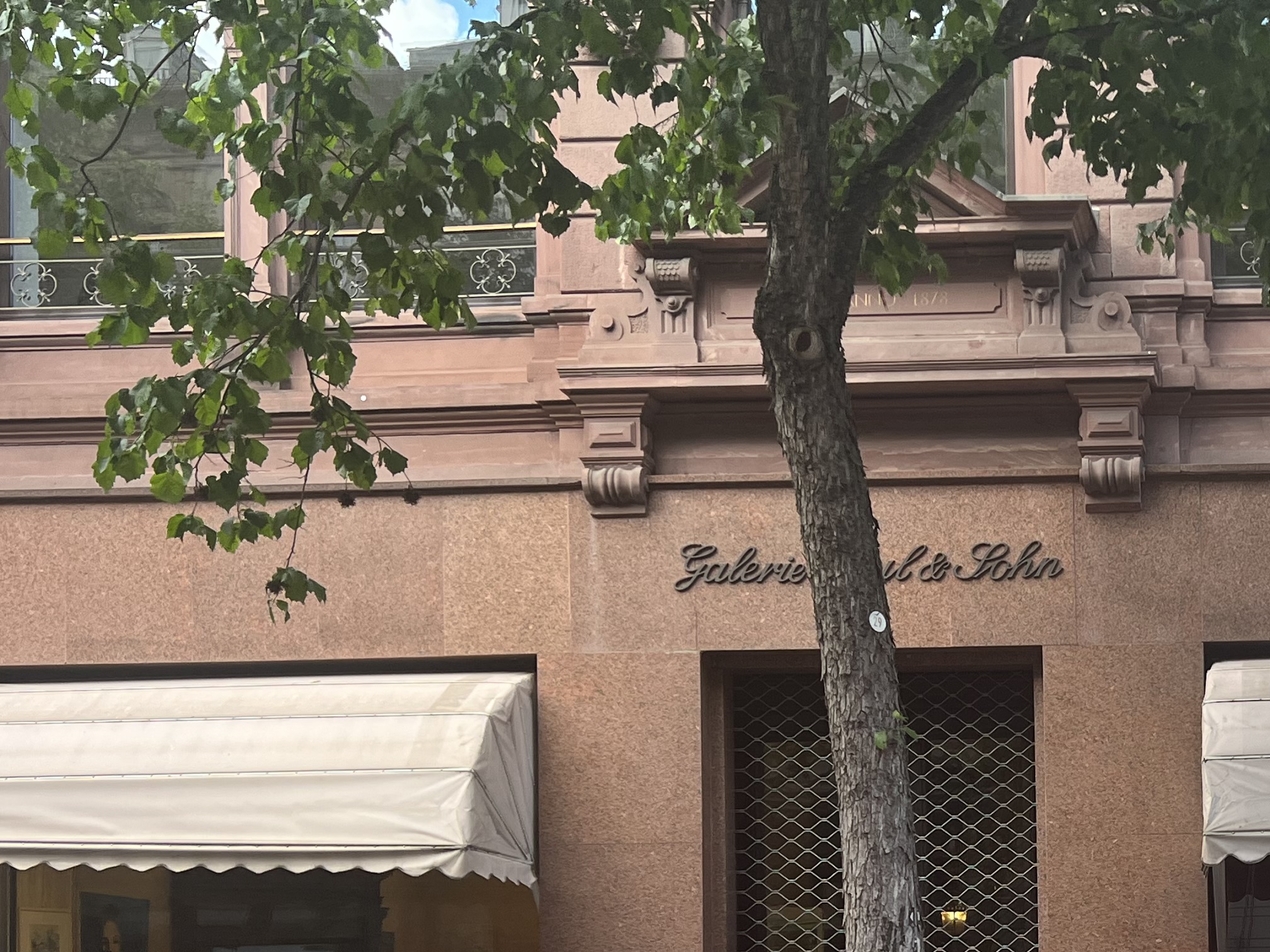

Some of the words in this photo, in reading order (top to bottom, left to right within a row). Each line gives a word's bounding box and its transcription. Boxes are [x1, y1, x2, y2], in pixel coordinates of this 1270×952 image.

[850, 293, 896, 307] NNO
[673, 542, 809, 592] Galerie
[918, 551, 951, 583] &
[954, 539, 1064, 583] Sohn
